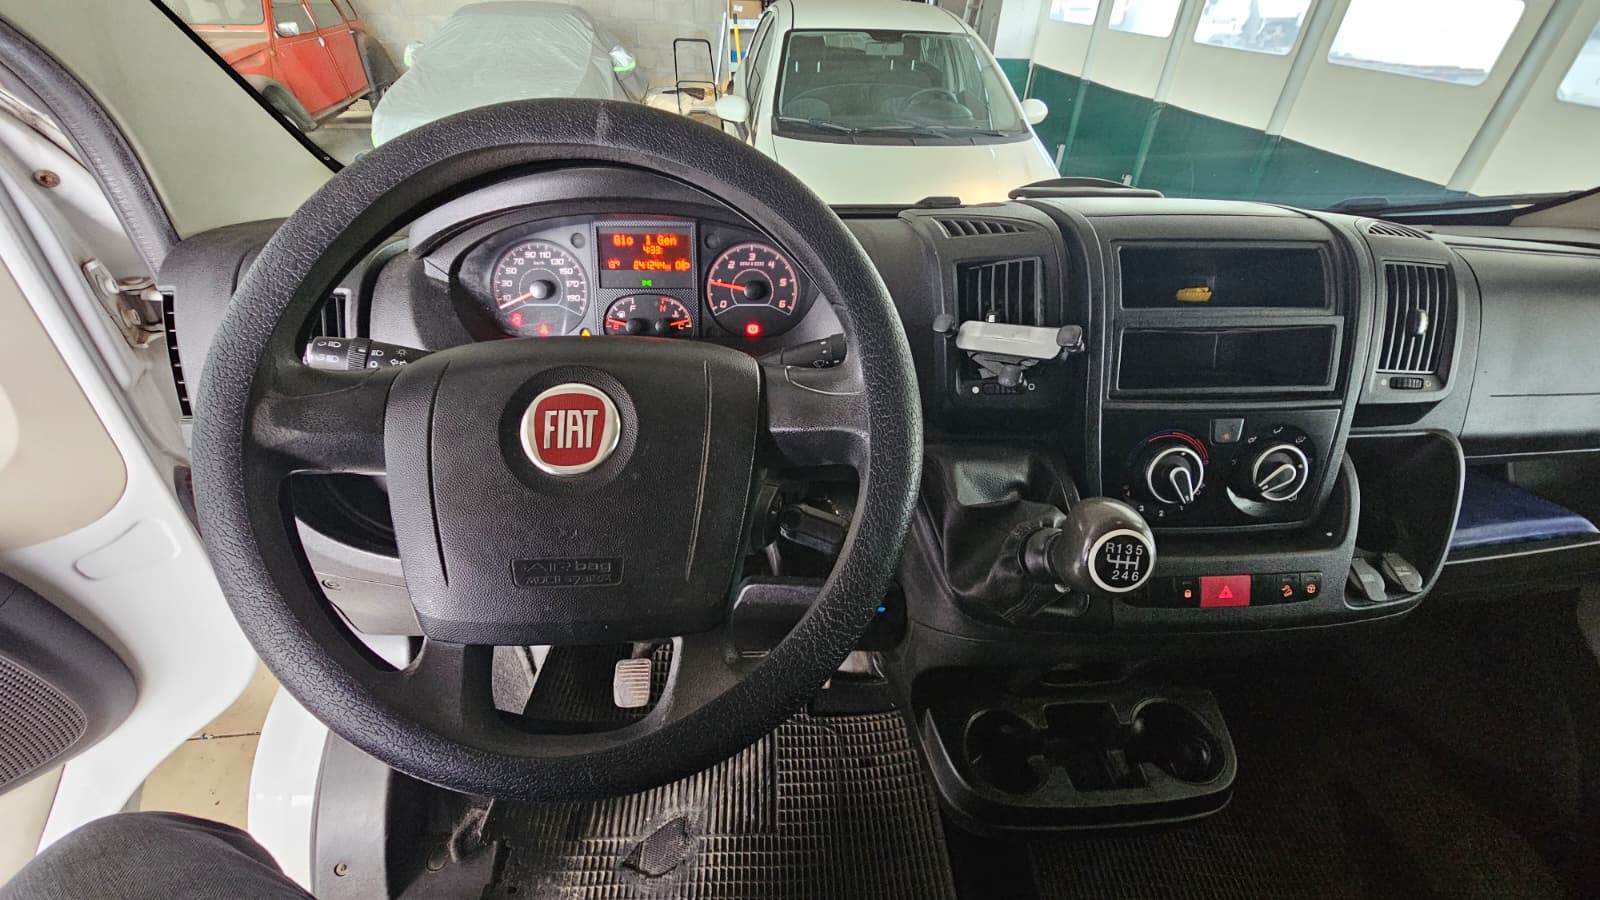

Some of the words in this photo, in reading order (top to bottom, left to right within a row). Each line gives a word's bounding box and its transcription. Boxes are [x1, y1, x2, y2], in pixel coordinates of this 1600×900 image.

[657, 233, 678, 247] Gen
[524, 251, 537, 259] 90
[540, 251, 552, 259] 110
[749, 252, 757, 262] 3
[513, 257, 525, 266] 70
[550, 257, 565, 266] 130
[727, 260, 736, 269] 2
[767, 260, 776, 269] 4
[505, 267, 518, 275] 50
[559, 267, 574, 275] 150
[501, 280, 513, 288] 30
[565, 280, 579, 288] 170
[779, 278, 787, 287] 5
[567, 294, 581, 302] 190
[629, 304, 637, 312] F
[659, 304, 667, 313] H
[720, 300, 728, 309] 0
[778, 300, 786, 308] 6
[543, 409, 599, 449] FIAT
